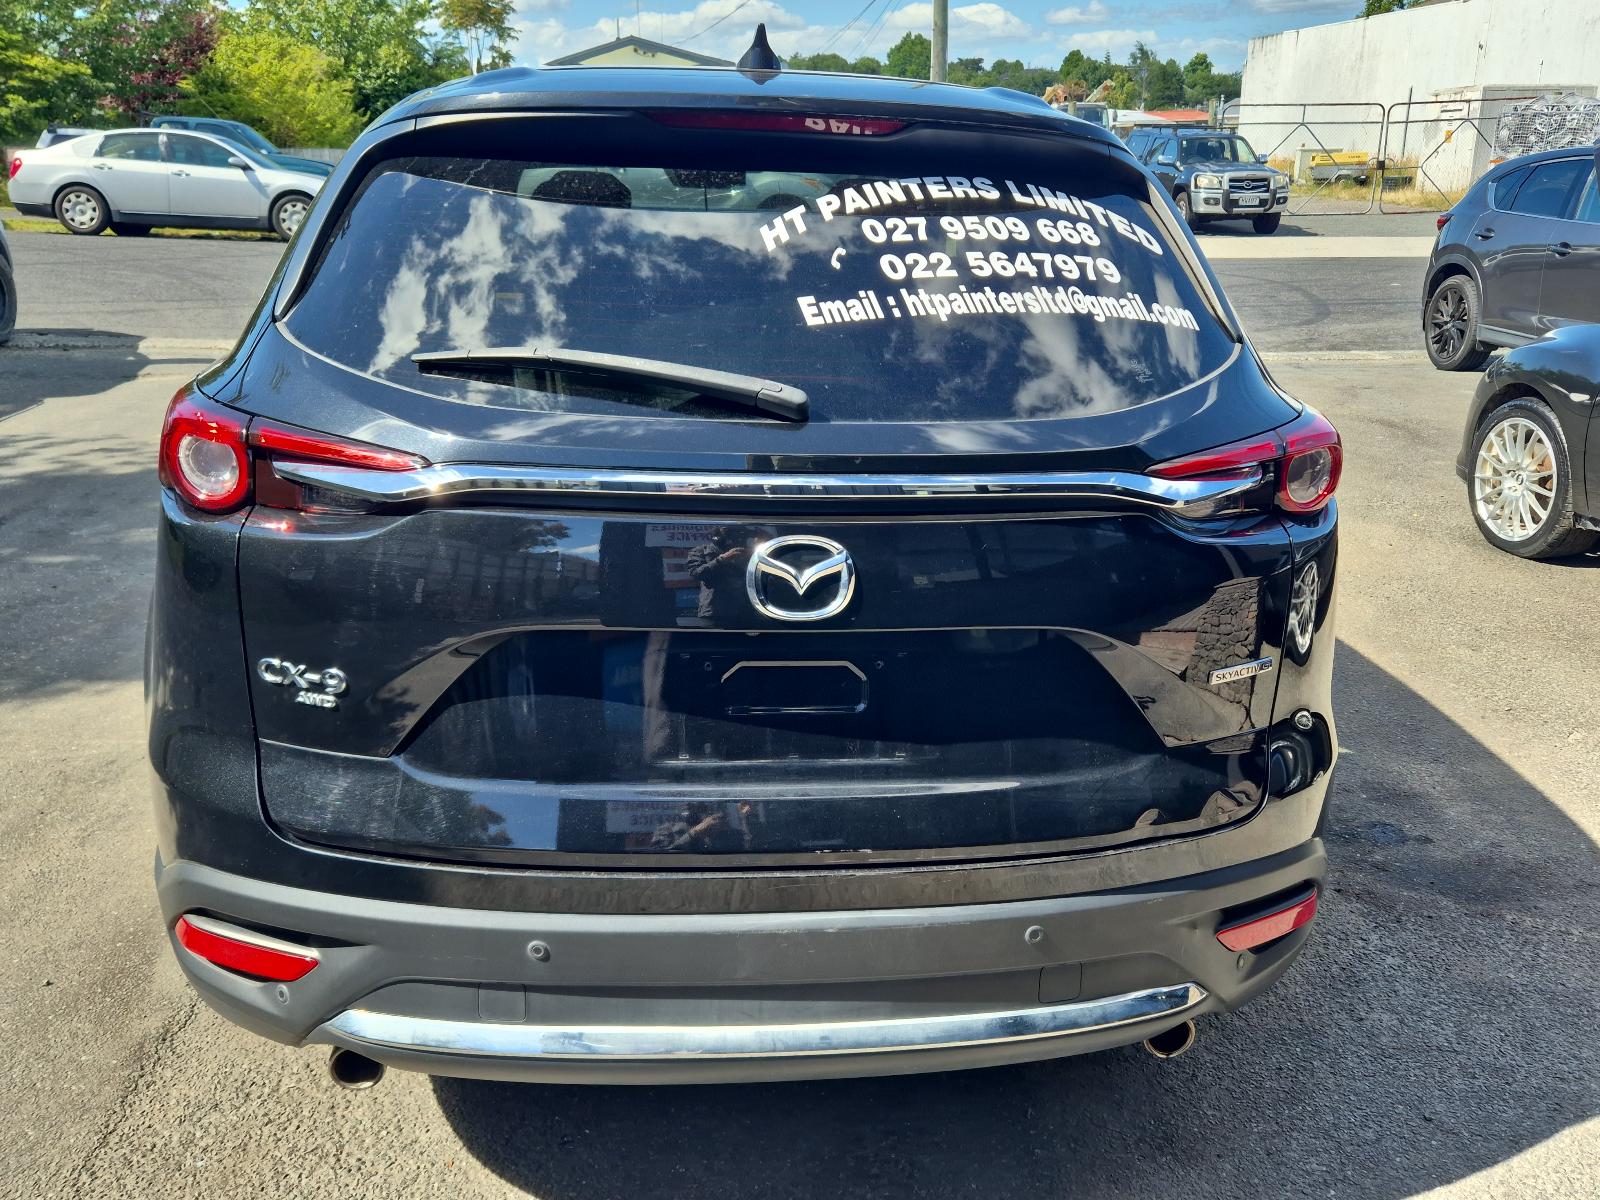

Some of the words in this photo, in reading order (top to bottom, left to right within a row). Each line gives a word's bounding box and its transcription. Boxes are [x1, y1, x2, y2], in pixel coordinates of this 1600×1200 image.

[759, 204, 807, 252] HT
[816, 176, 1000, 222] PAINTERS
[1004, 179, 1164, 256] LIMITED
[861, 216, 928, 243] 027
[939, 215, 1031, 242] 9509
[1036, 218, 1101, 247] 668
[879, 252, 959, 280] 022
[965, 251, 1122, 284] 5647979
[797, 289, 885, 327] Email
[900, 284, 1200, 331] htpaintersltd@gmail.com
[257, 657, 347, 694] CX-9
[1215, 664, 1261, 682] SKYACTIV
